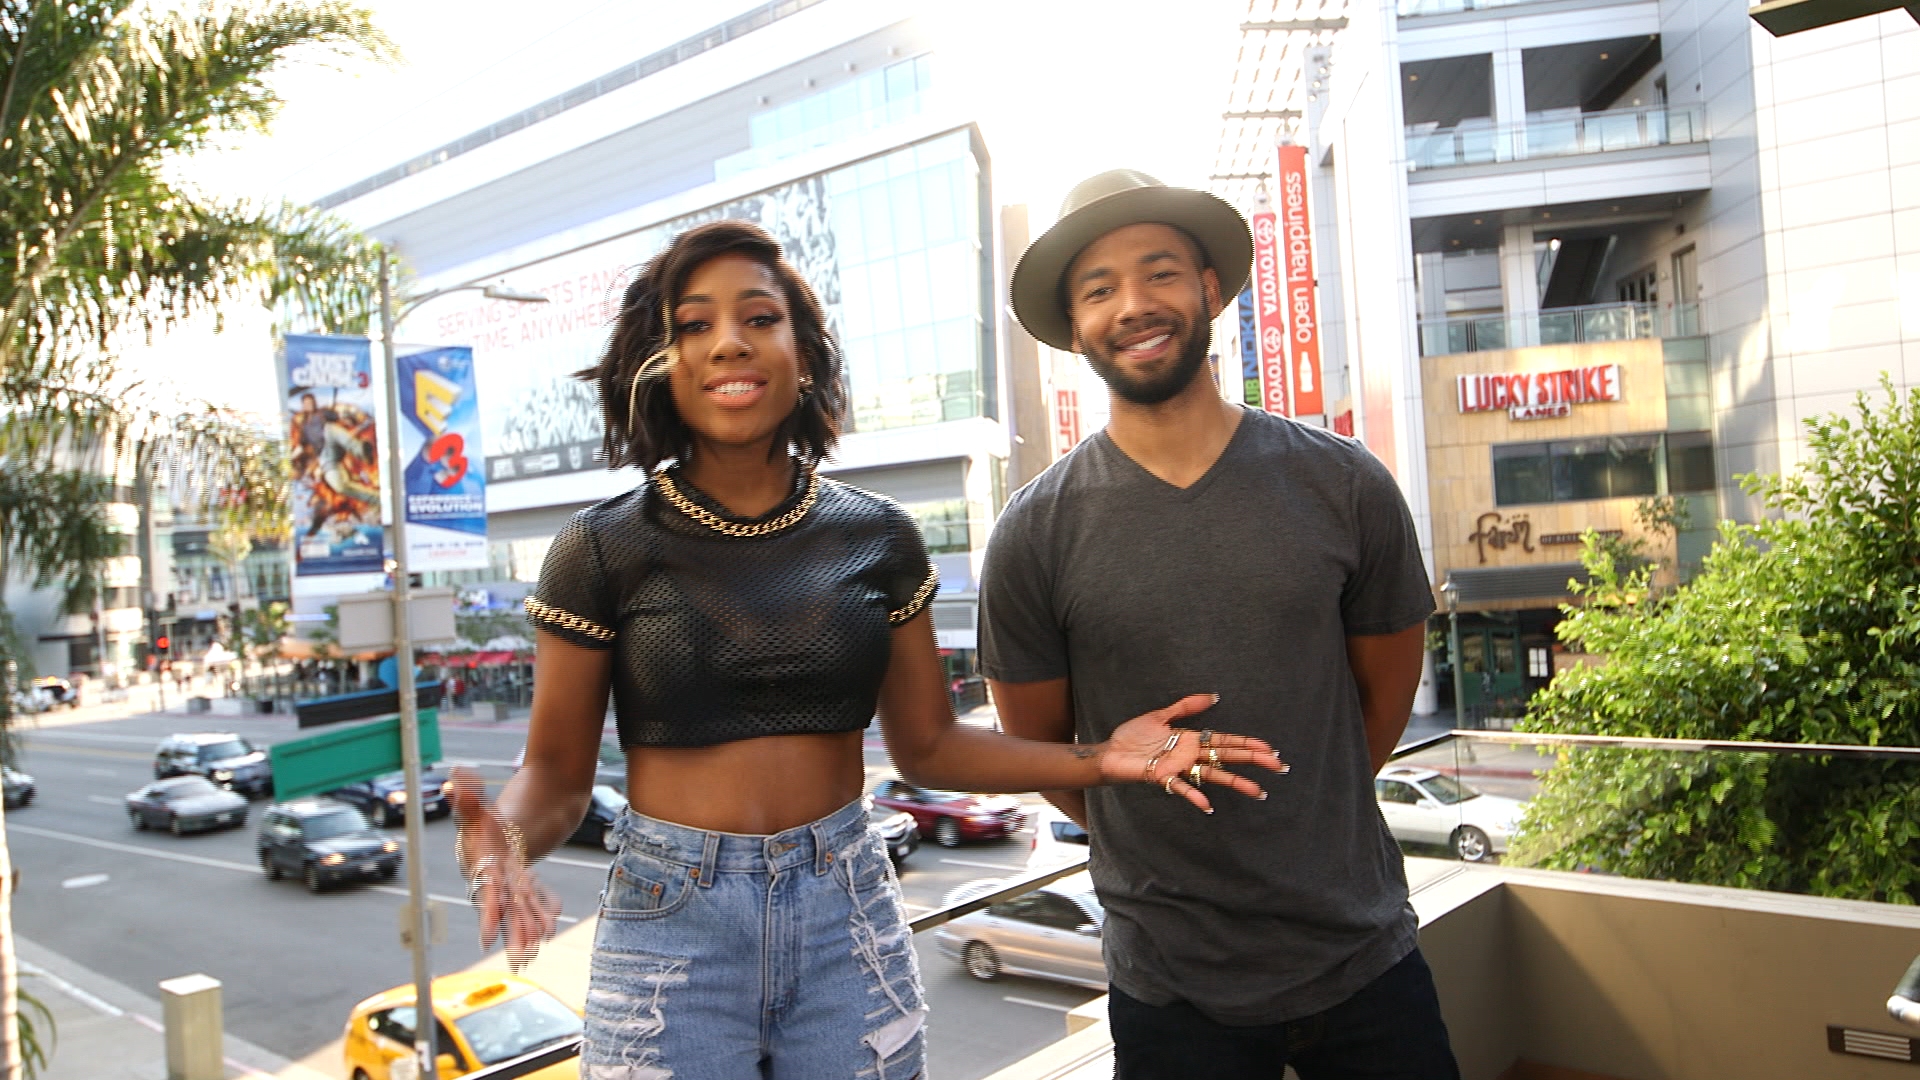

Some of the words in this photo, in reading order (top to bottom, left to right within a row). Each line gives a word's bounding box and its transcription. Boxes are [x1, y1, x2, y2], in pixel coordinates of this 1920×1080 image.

[1284, 171, 1309, 281] happiness
[438, 300, 501, 338] SERVING
[579, 264, 629, 299] FANS
[1259, 245, 1278, 316] TOYOTA
[521, 297, 621, 343] ANYWHERE
[1238, 288, 1259, 378] NOKIA
[1293, 287, 1314, 343] open
[1267, 353, 1285, 415] TOYOT
[1461, 374, 1531, 411] LUCKY
[1535, 364, 1615, 404] STRIKE
[1511, 405, 1569, 420] LANES
[1057, 390, 1080, 454] ESP
[409, 501, 483, 514] EVOLUTION
